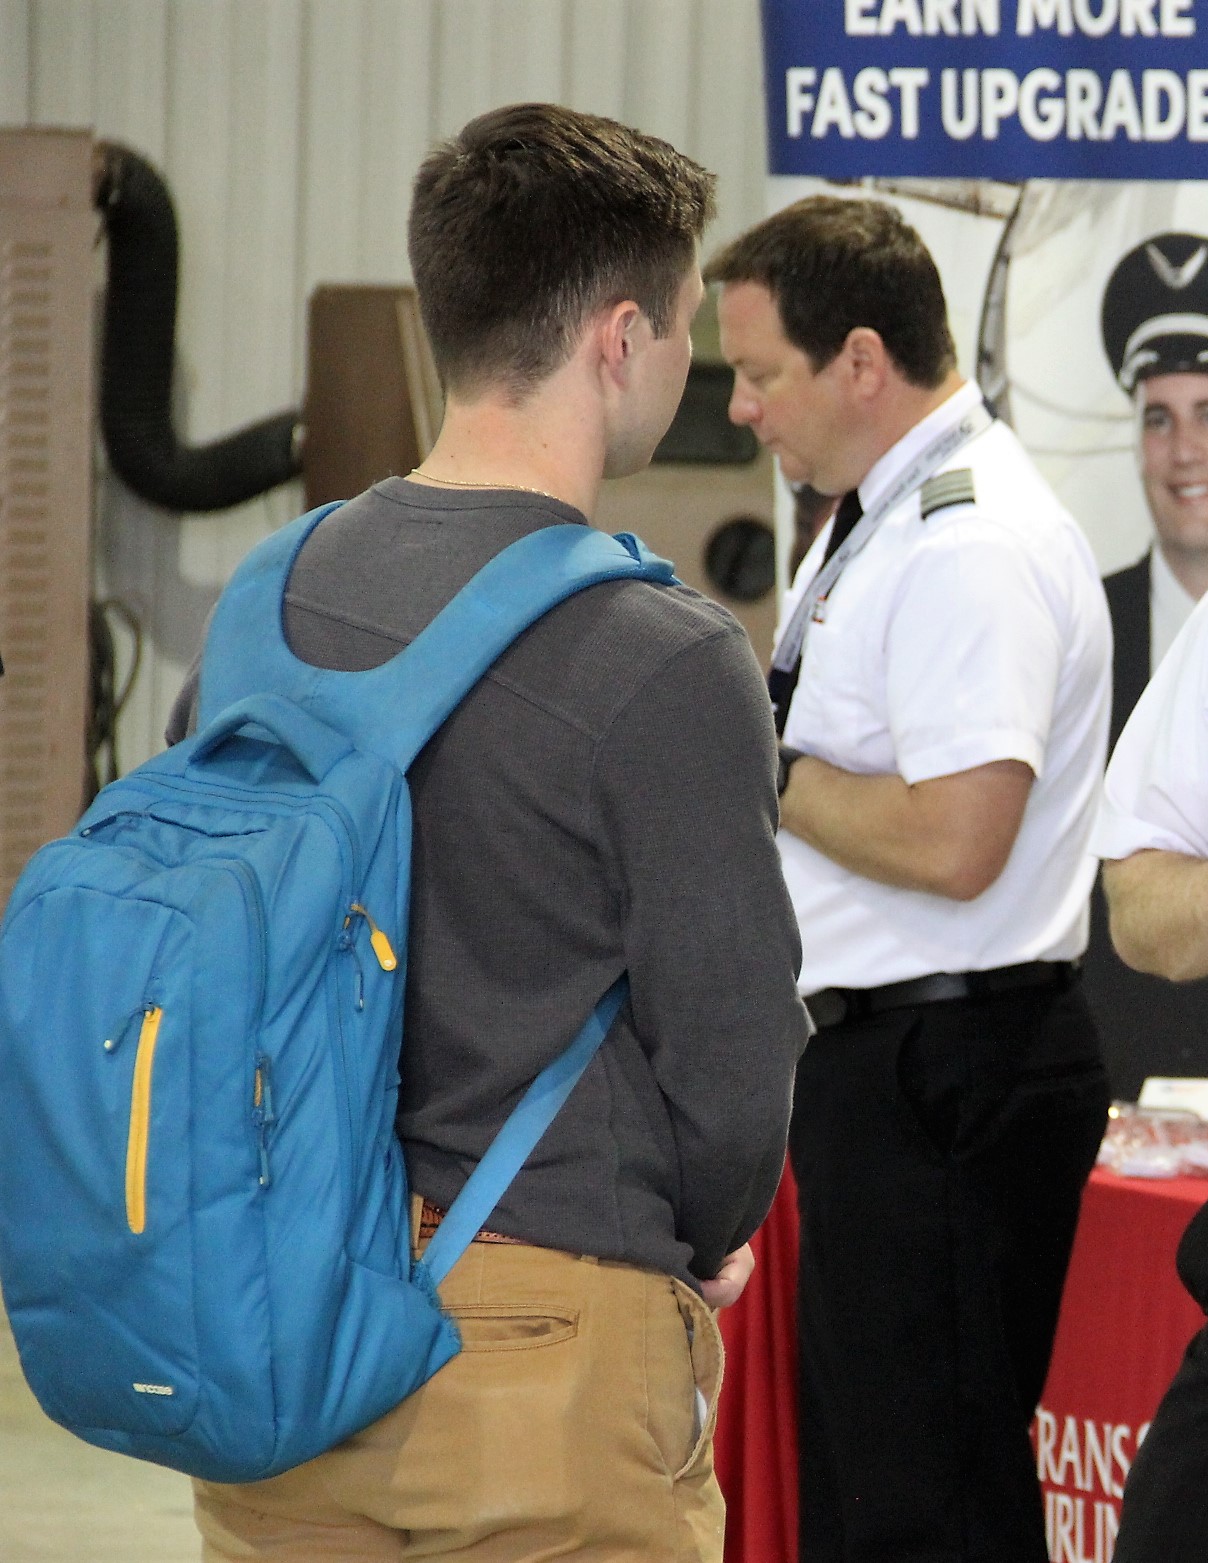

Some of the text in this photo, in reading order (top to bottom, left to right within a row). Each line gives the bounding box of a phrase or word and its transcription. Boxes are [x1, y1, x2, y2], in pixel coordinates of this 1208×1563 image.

[785, 66, 930, 139] FAST
[1035, 1404, 1131, 1500] RANS
[1044, 1490, 1122, 1563] IRLIN
